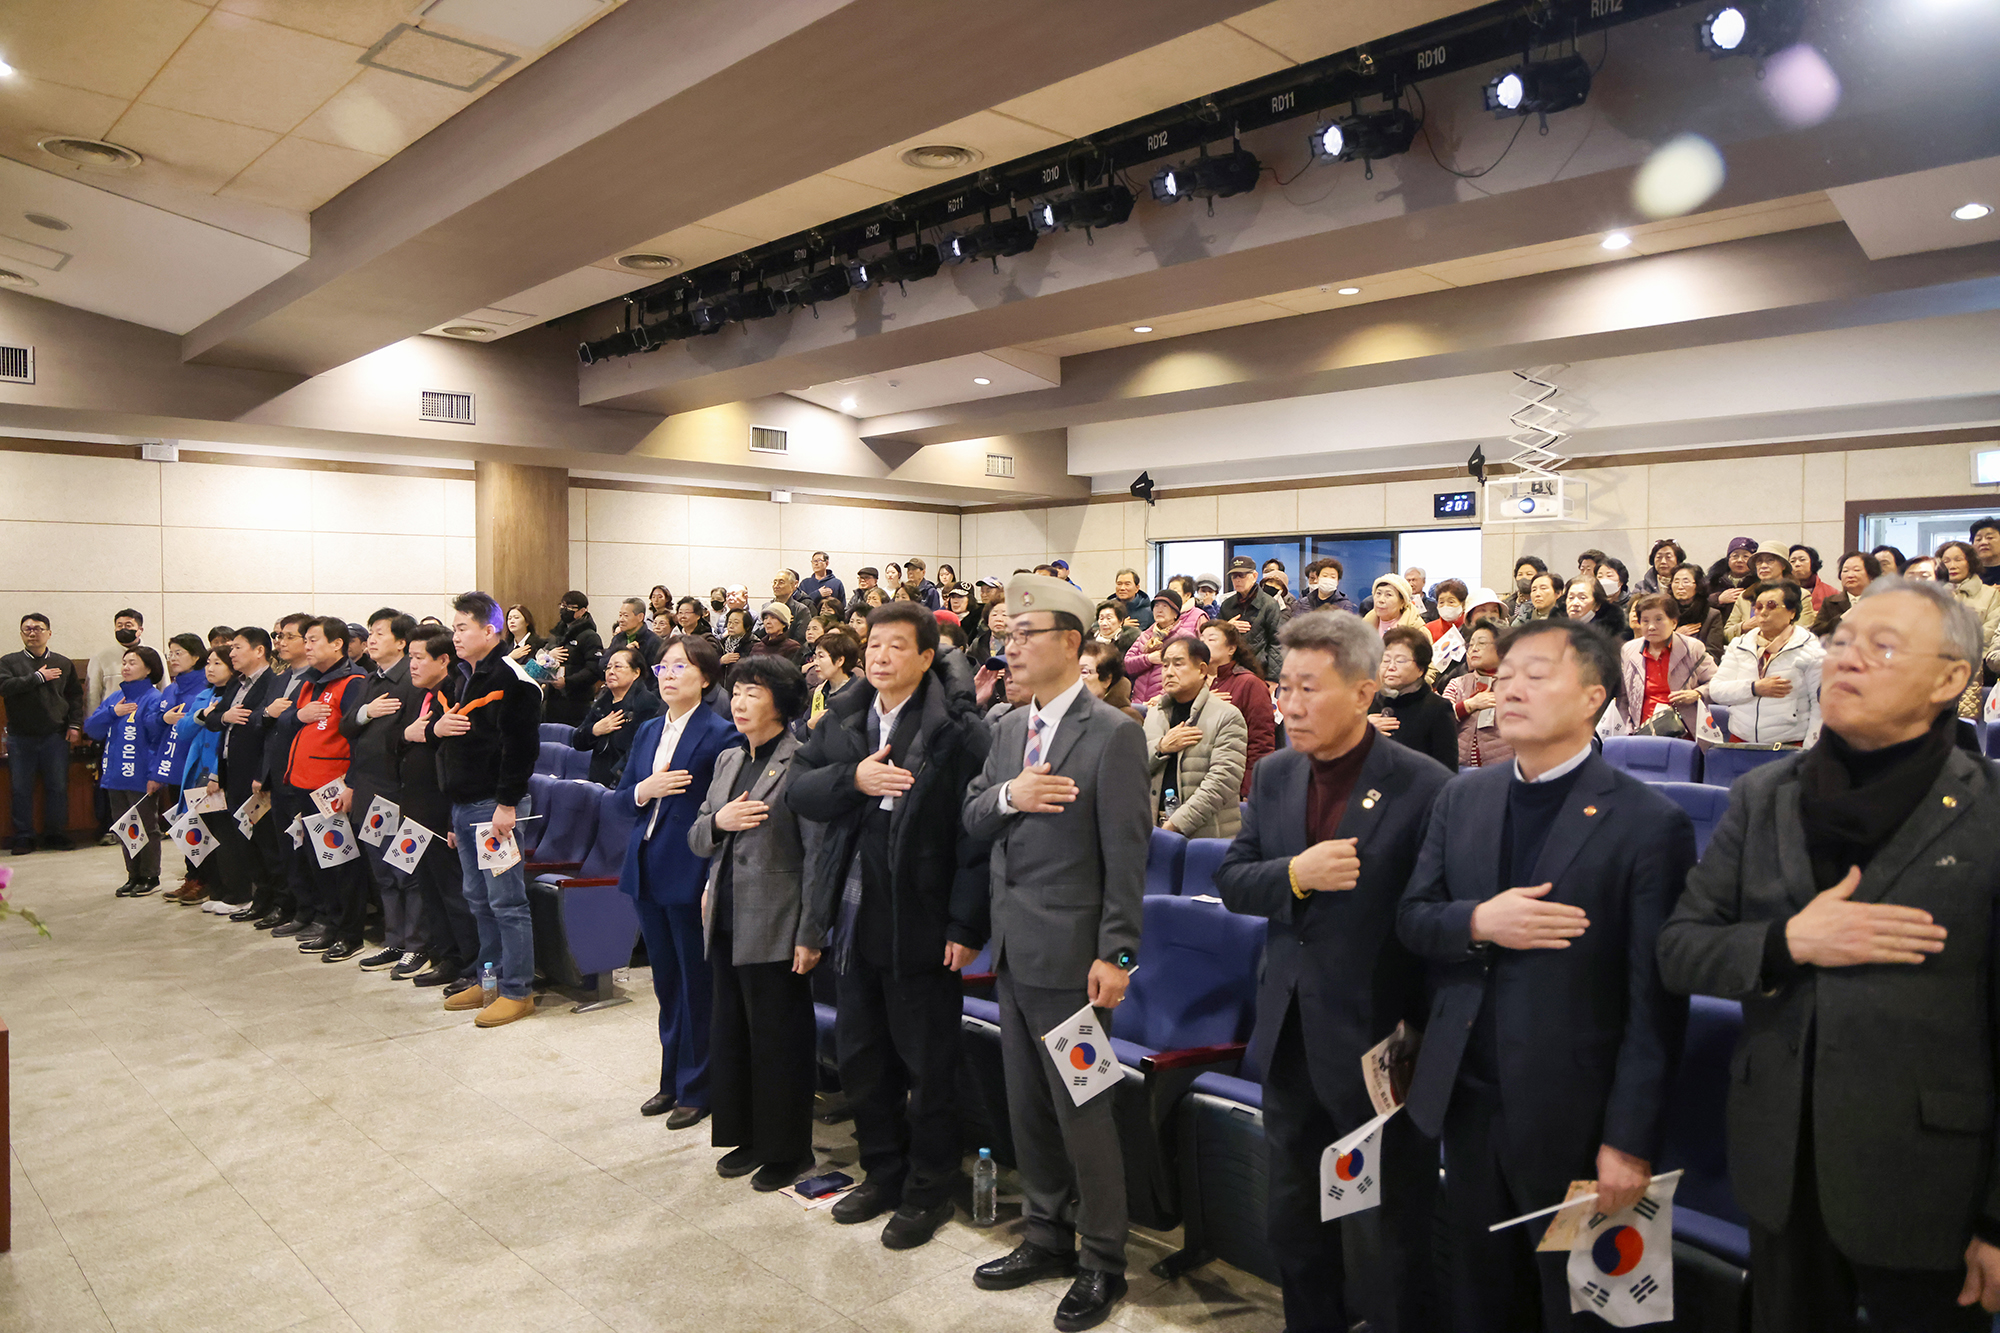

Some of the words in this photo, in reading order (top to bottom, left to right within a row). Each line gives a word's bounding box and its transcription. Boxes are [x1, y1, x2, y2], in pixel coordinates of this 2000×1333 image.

[1417, 45, 1446, 70] RD10
[1271, 91, 1295, 114] RD11
[1147, 130, 1168, 151] RD12
[121, 725, 137, 777] 홍은정
